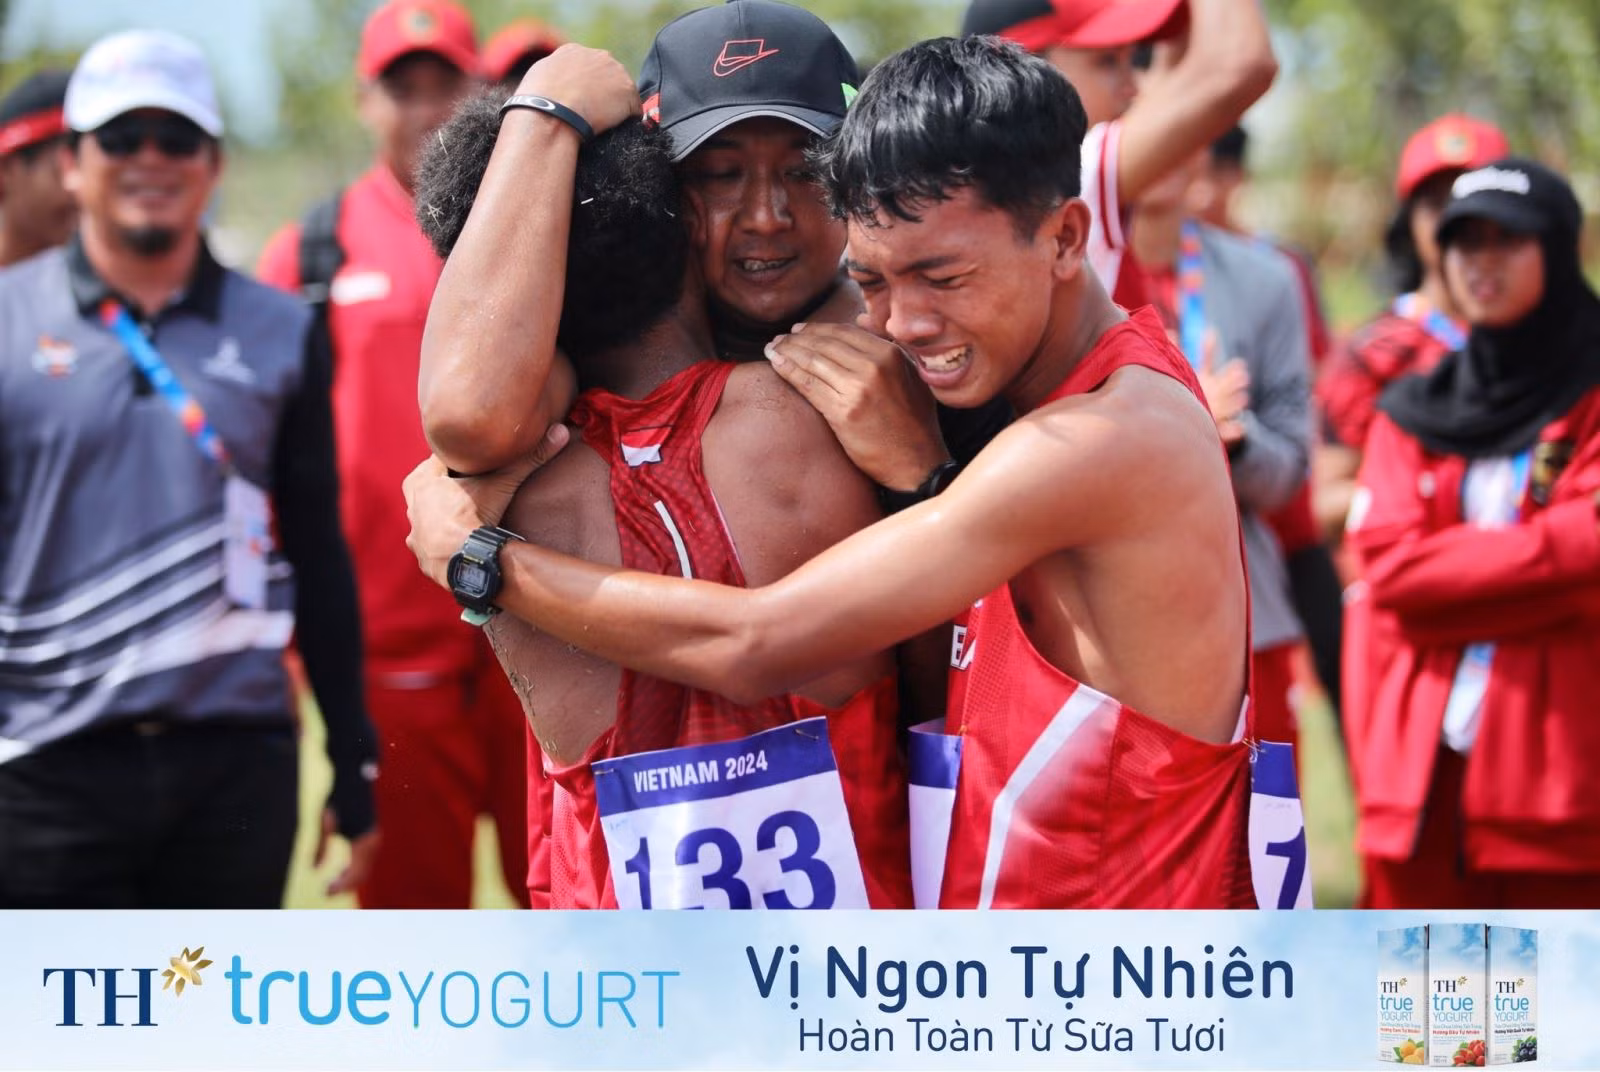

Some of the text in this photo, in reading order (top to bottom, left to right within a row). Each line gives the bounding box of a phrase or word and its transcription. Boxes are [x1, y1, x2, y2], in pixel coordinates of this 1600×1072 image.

[634, 750, 768, 793] VIETNAM 2024
[625, 810, 836, 909] 133
